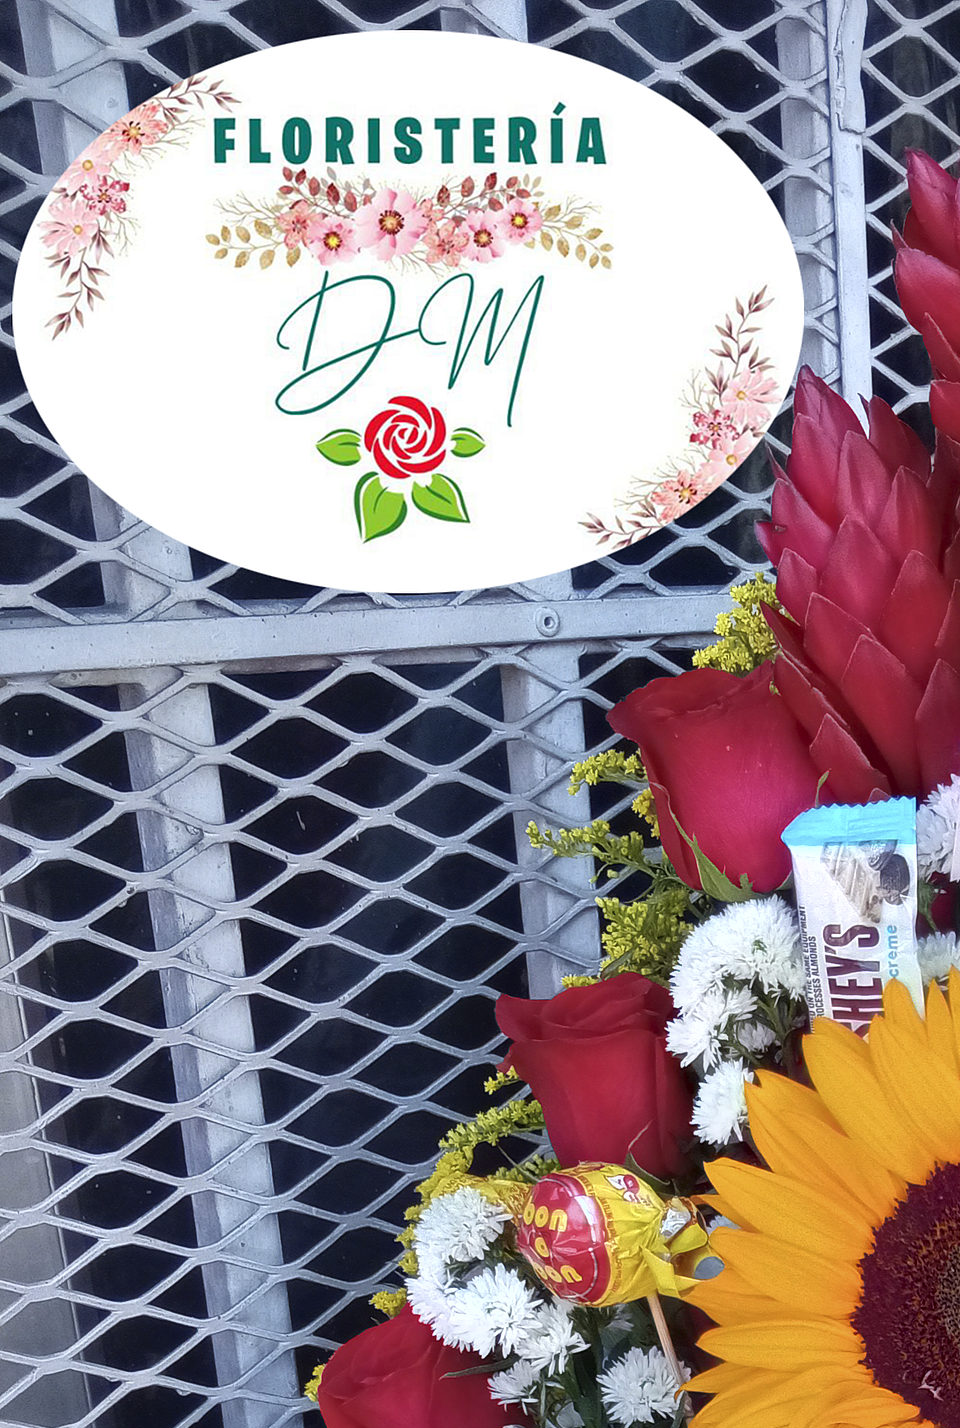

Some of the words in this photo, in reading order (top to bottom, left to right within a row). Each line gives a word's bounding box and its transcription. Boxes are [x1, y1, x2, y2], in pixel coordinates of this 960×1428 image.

[808, 936, 819, 977] ALMONDS
[887, 925, 900, 978] creme
[822, 924, 885, 1038] HEY'S
